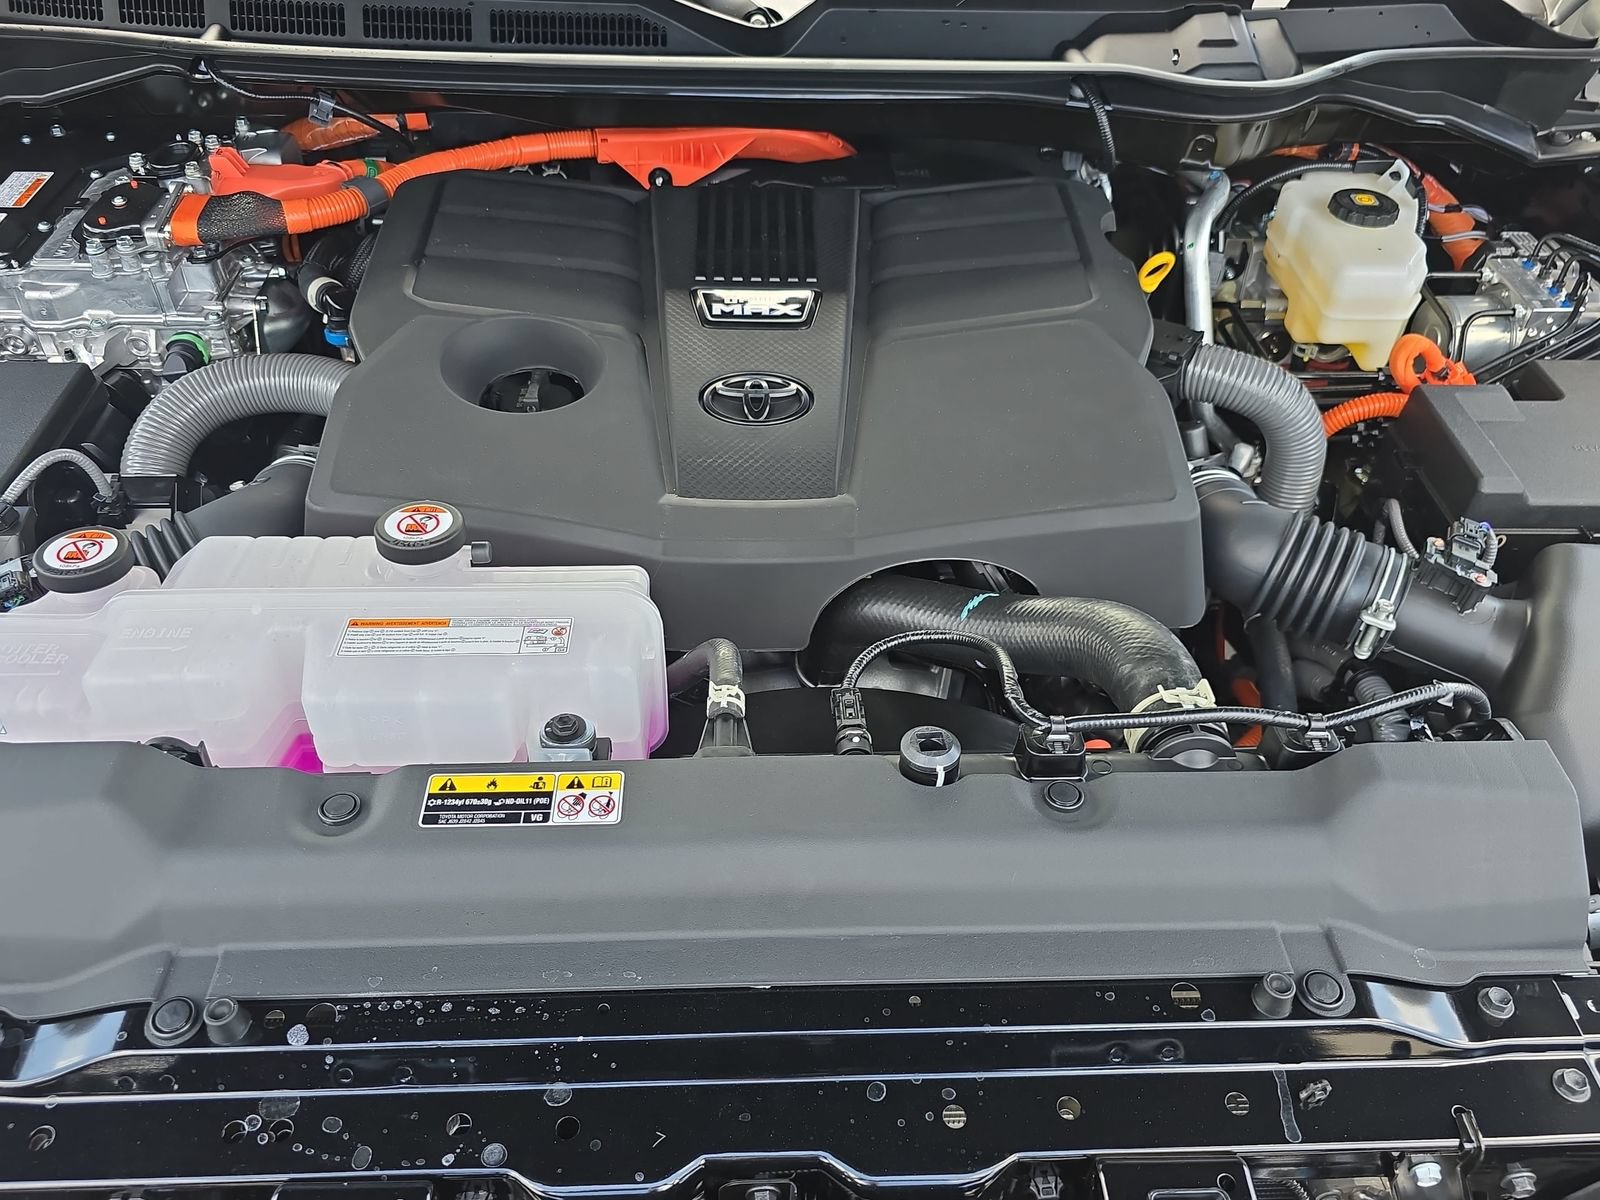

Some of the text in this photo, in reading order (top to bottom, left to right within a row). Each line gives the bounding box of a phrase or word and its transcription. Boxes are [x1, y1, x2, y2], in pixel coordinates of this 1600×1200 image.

[711, 303, 802, 316] MAX
[119, 627, 193, 639] ENGINE
[533, 797, 550, 805] (POE)
[530, 813, 543, 822] VG
